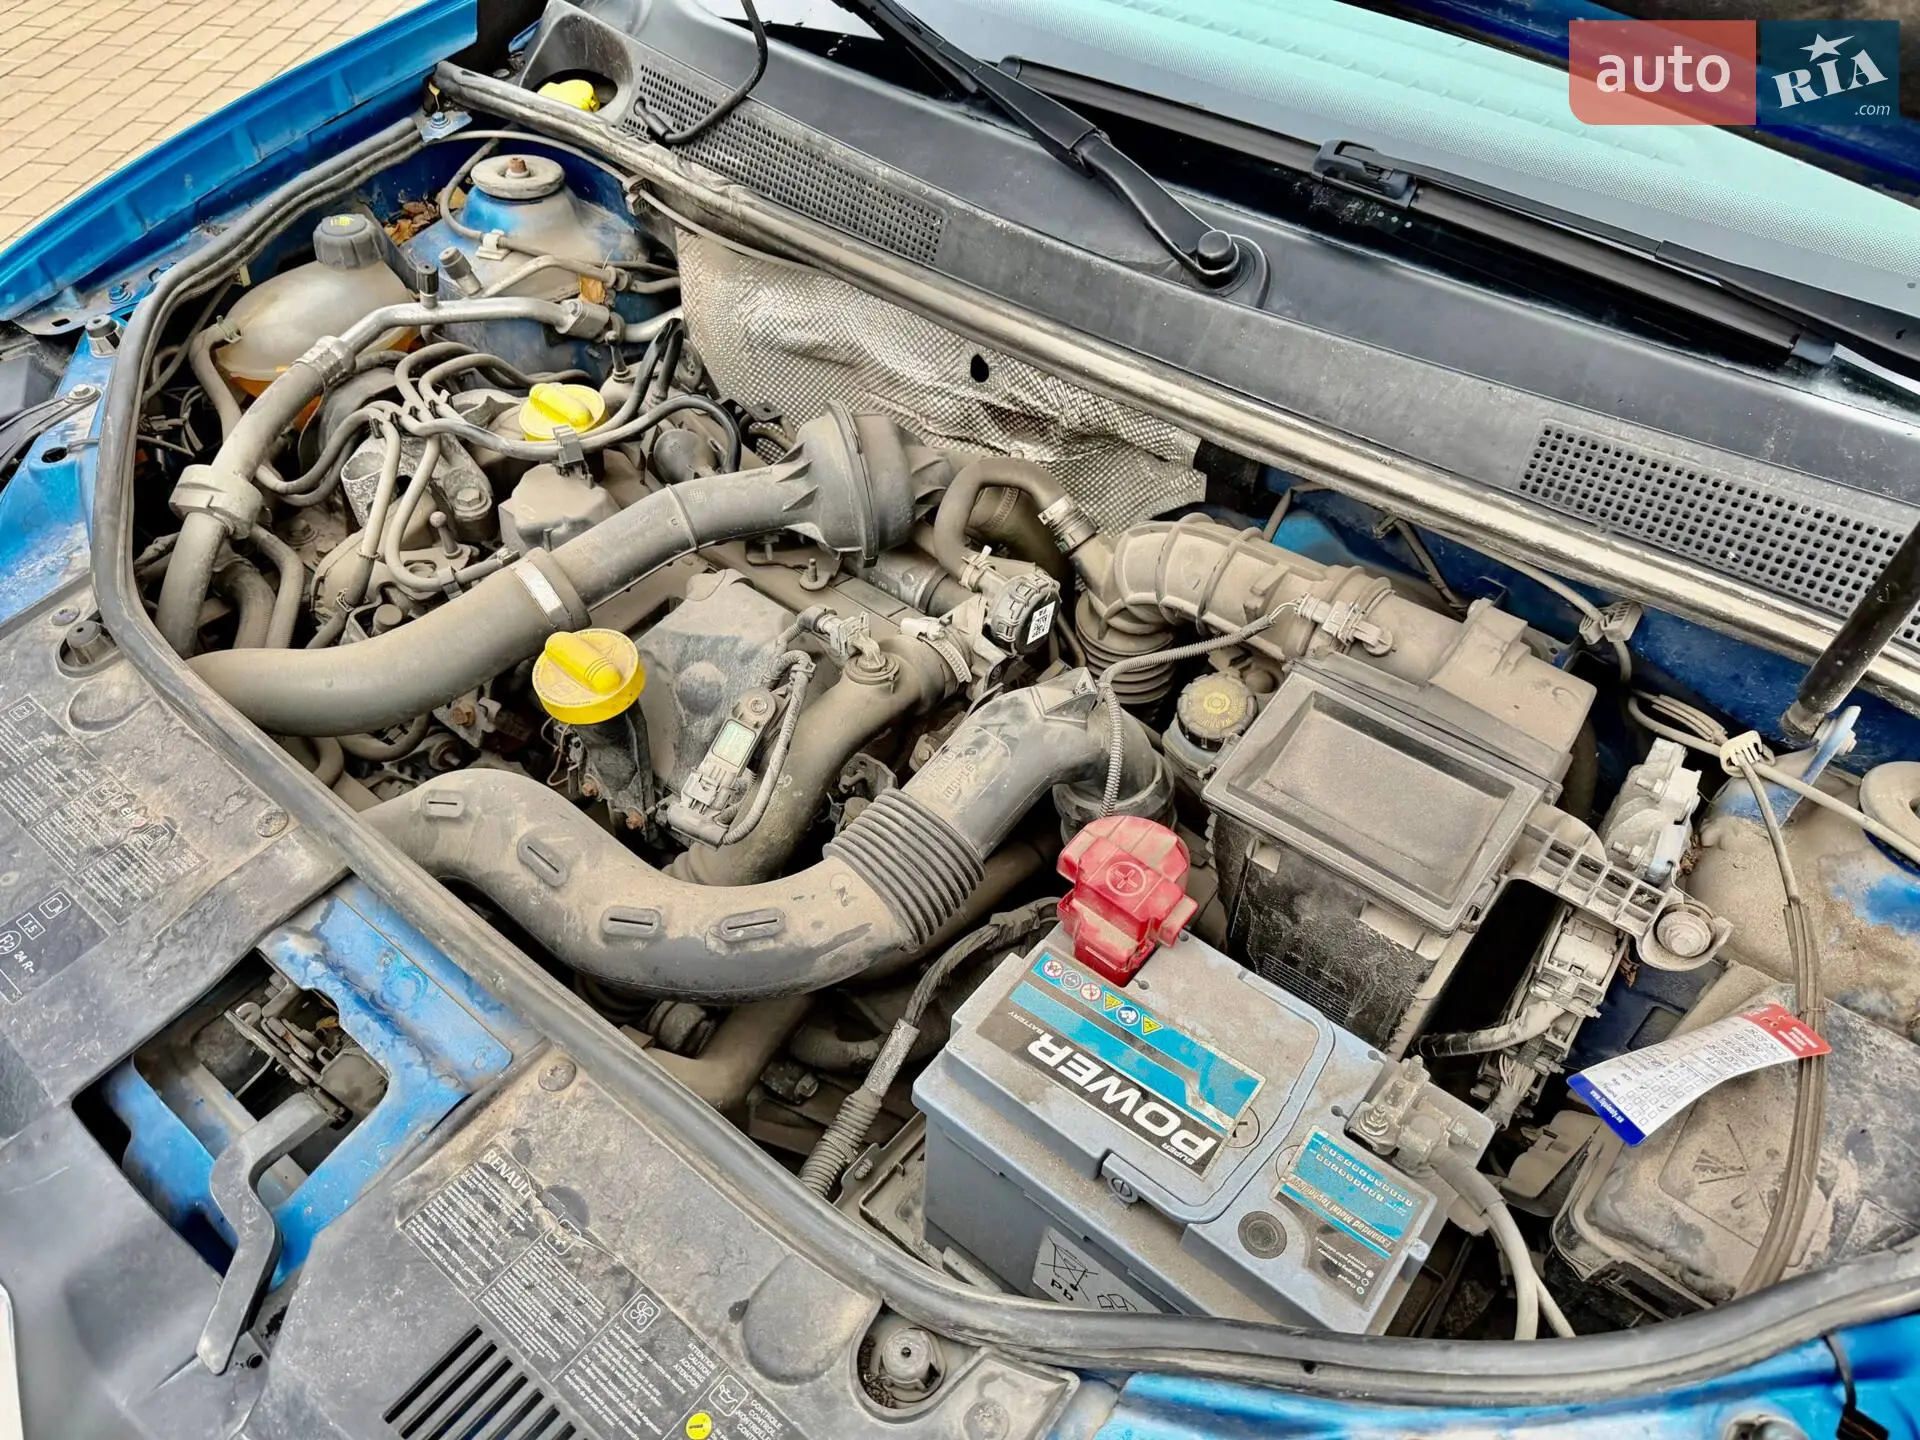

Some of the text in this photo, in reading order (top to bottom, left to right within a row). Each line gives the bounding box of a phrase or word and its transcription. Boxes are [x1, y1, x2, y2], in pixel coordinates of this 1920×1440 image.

[1006, 1008, 1044, 1034] BATTERY
[1025, 1029, 1217, 1160] POWER
[1160, 1140, 1195, 1166] SUPER
[482, 1149, 534, 1200] RENAULT
[1049, 1278, 1074, 1301] Pb
[686, 1352, 711, 1377] CAUTION
[747, 1408, 777, 1436] CONTROL
[749, 1398, 783, 1429] CONTROLE
